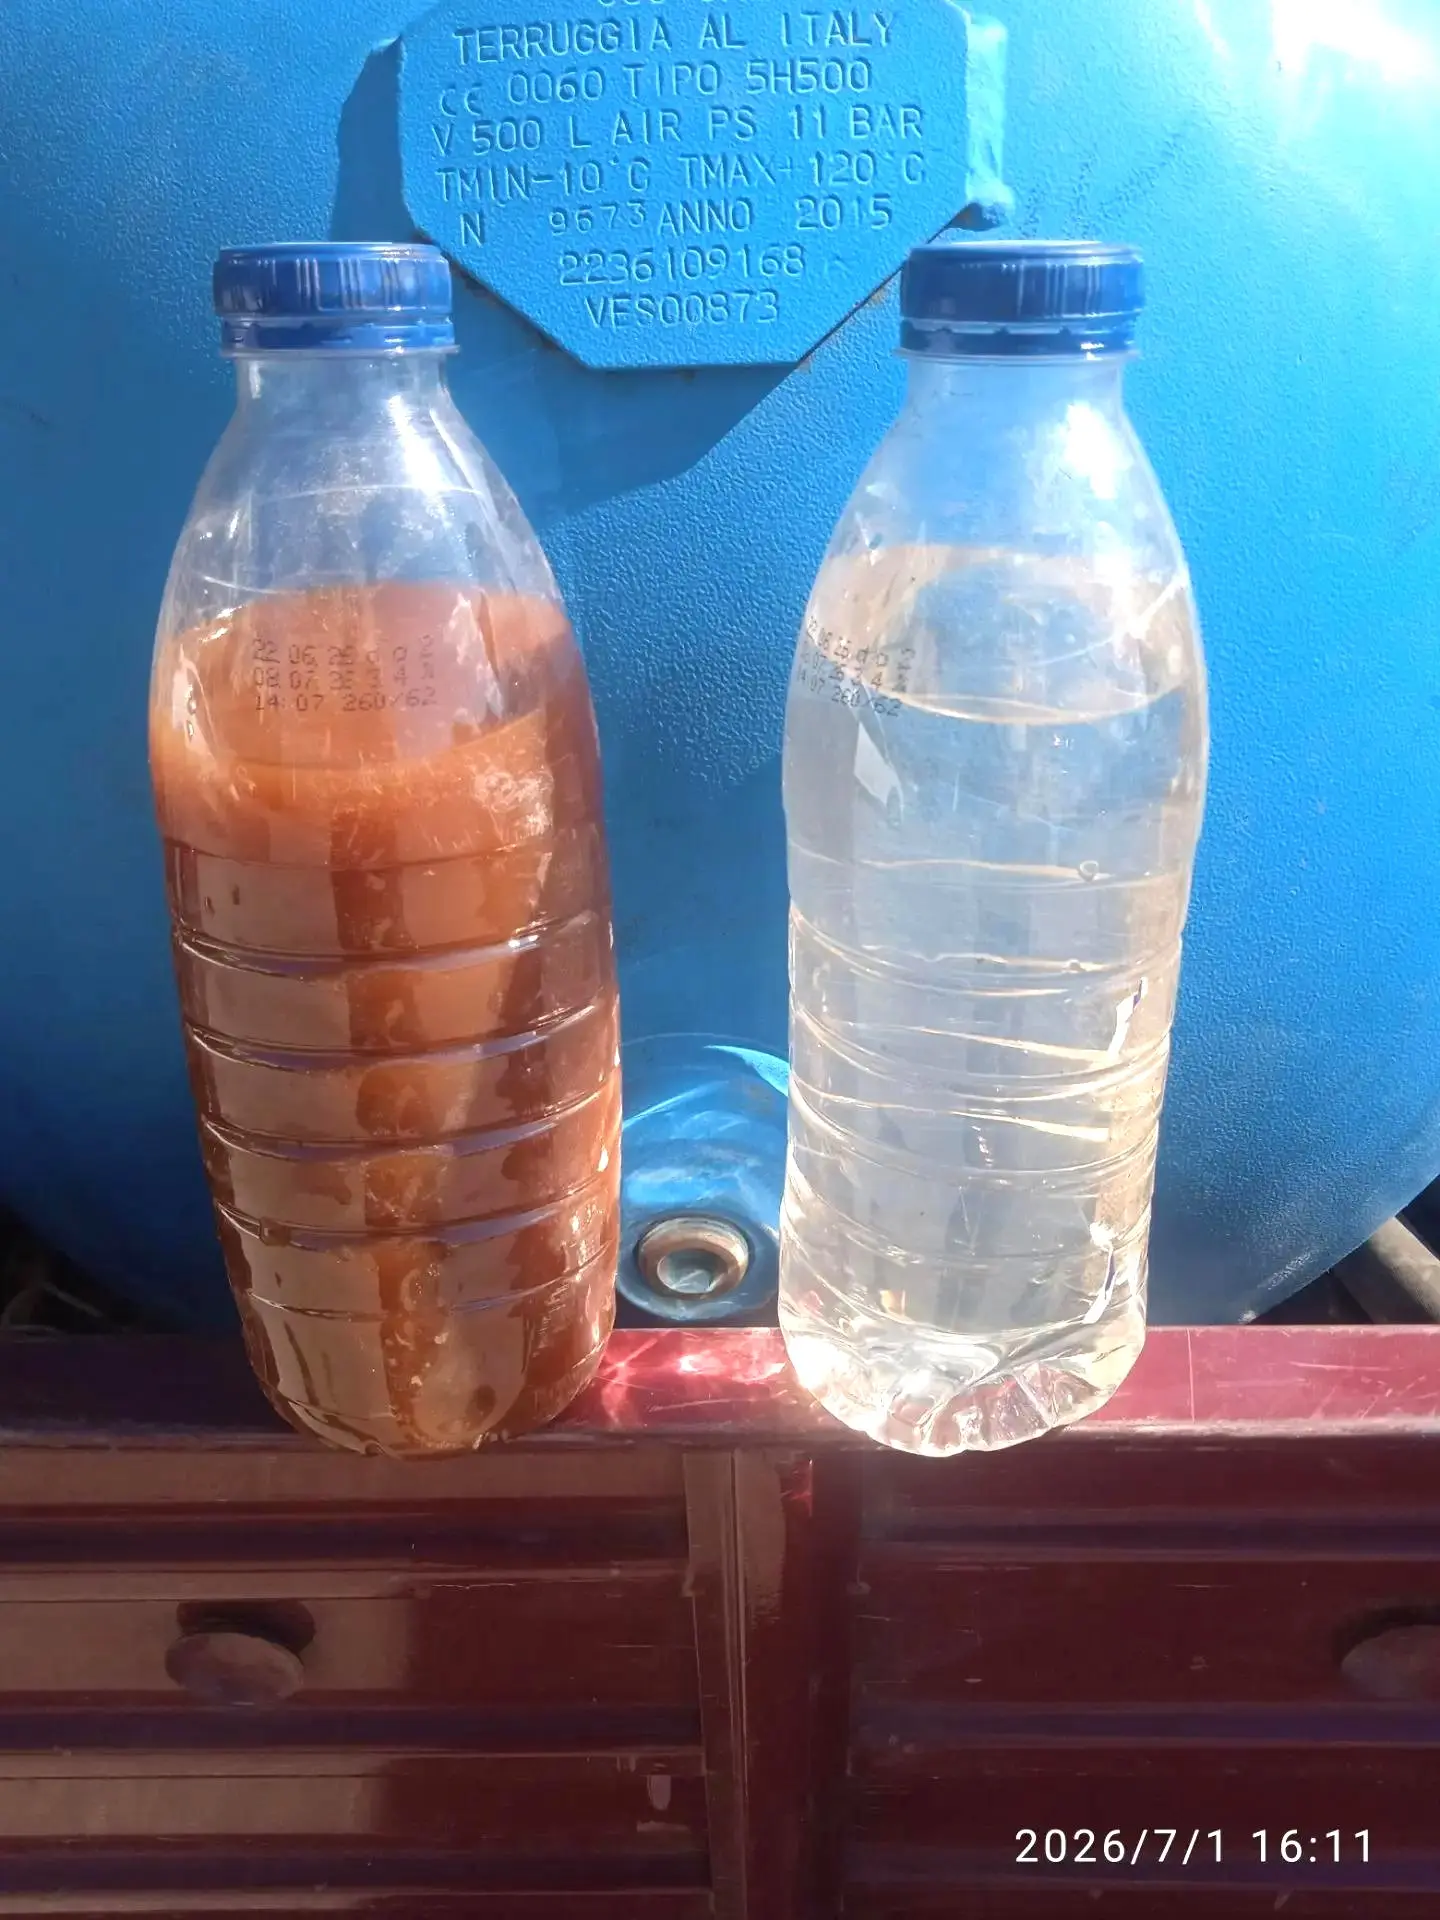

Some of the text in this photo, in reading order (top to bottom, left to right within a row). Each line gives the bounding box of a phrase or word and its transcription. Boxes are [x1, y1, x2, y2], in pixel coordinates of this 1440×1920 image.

[452, 10, 895, 65] TERRUGGIA AL ITALY
[508, 68, 604, 104] 0060
[622, 60, 722, 98] TIPO
[746, 56, 873, 95] 5H500
[431, 103, 926, 156] V 500 L AIR PS 11 BAR
[460, 193, 893, 248] N 9673 ANNO 2015
